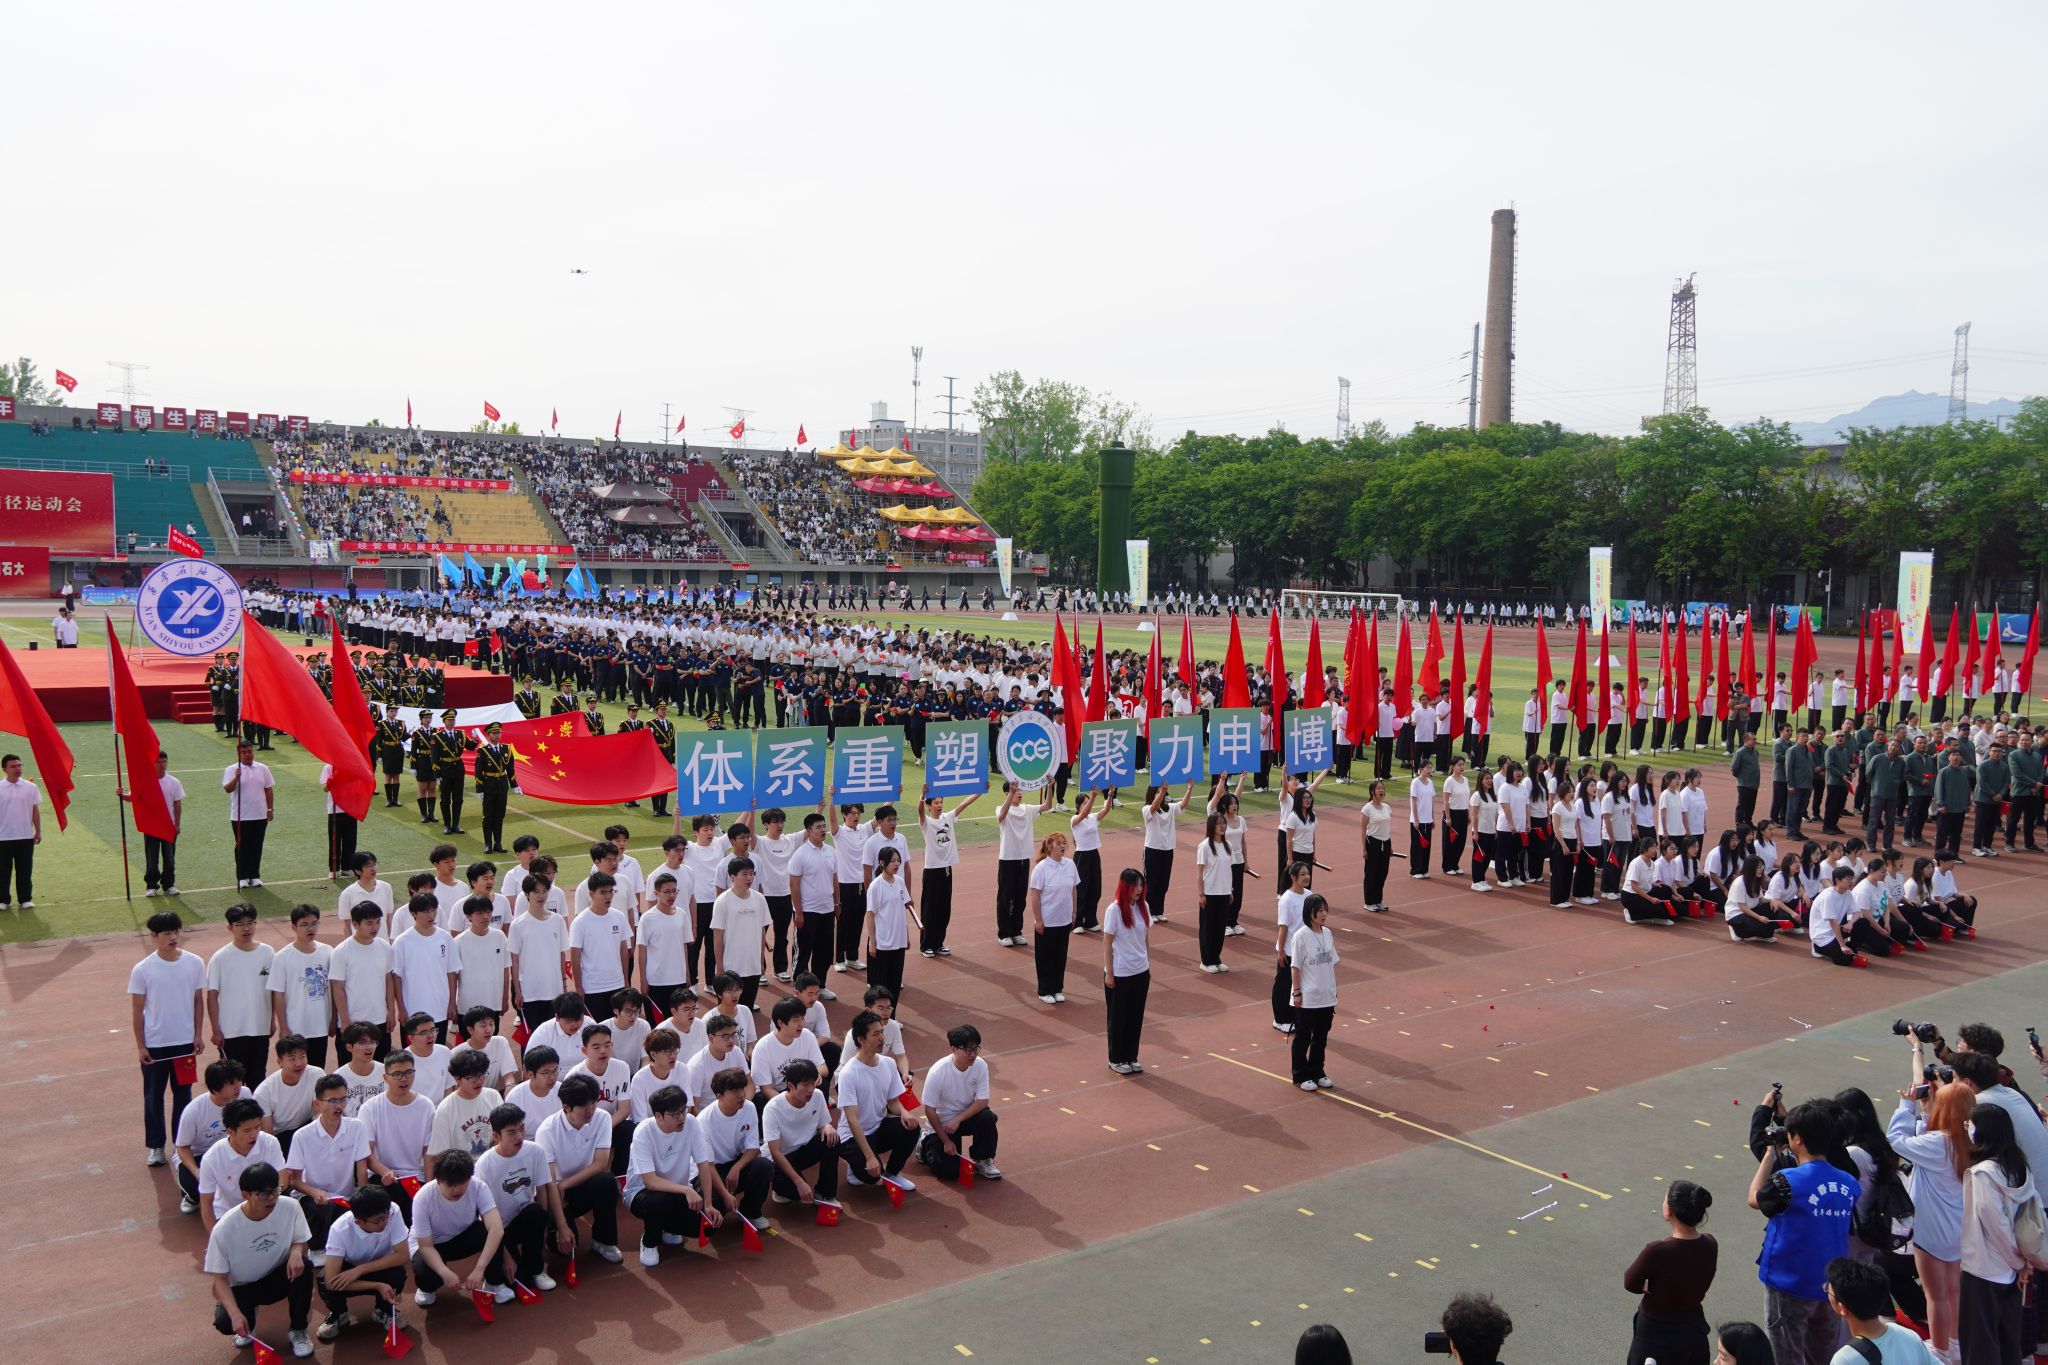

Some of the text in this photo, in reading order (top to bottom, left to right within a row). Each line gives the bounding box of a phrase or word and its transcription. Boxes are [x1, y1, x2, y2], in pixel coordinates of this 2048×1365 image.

[0, 495, 82, 512] 径运动会
[0, 562, 24, 576] 石大
[159, 632, 193, 649] SHIYOU
[199, 606, 237, 648] UNIVERSITY
[461, 1115, 490, 1131] BALNCE
